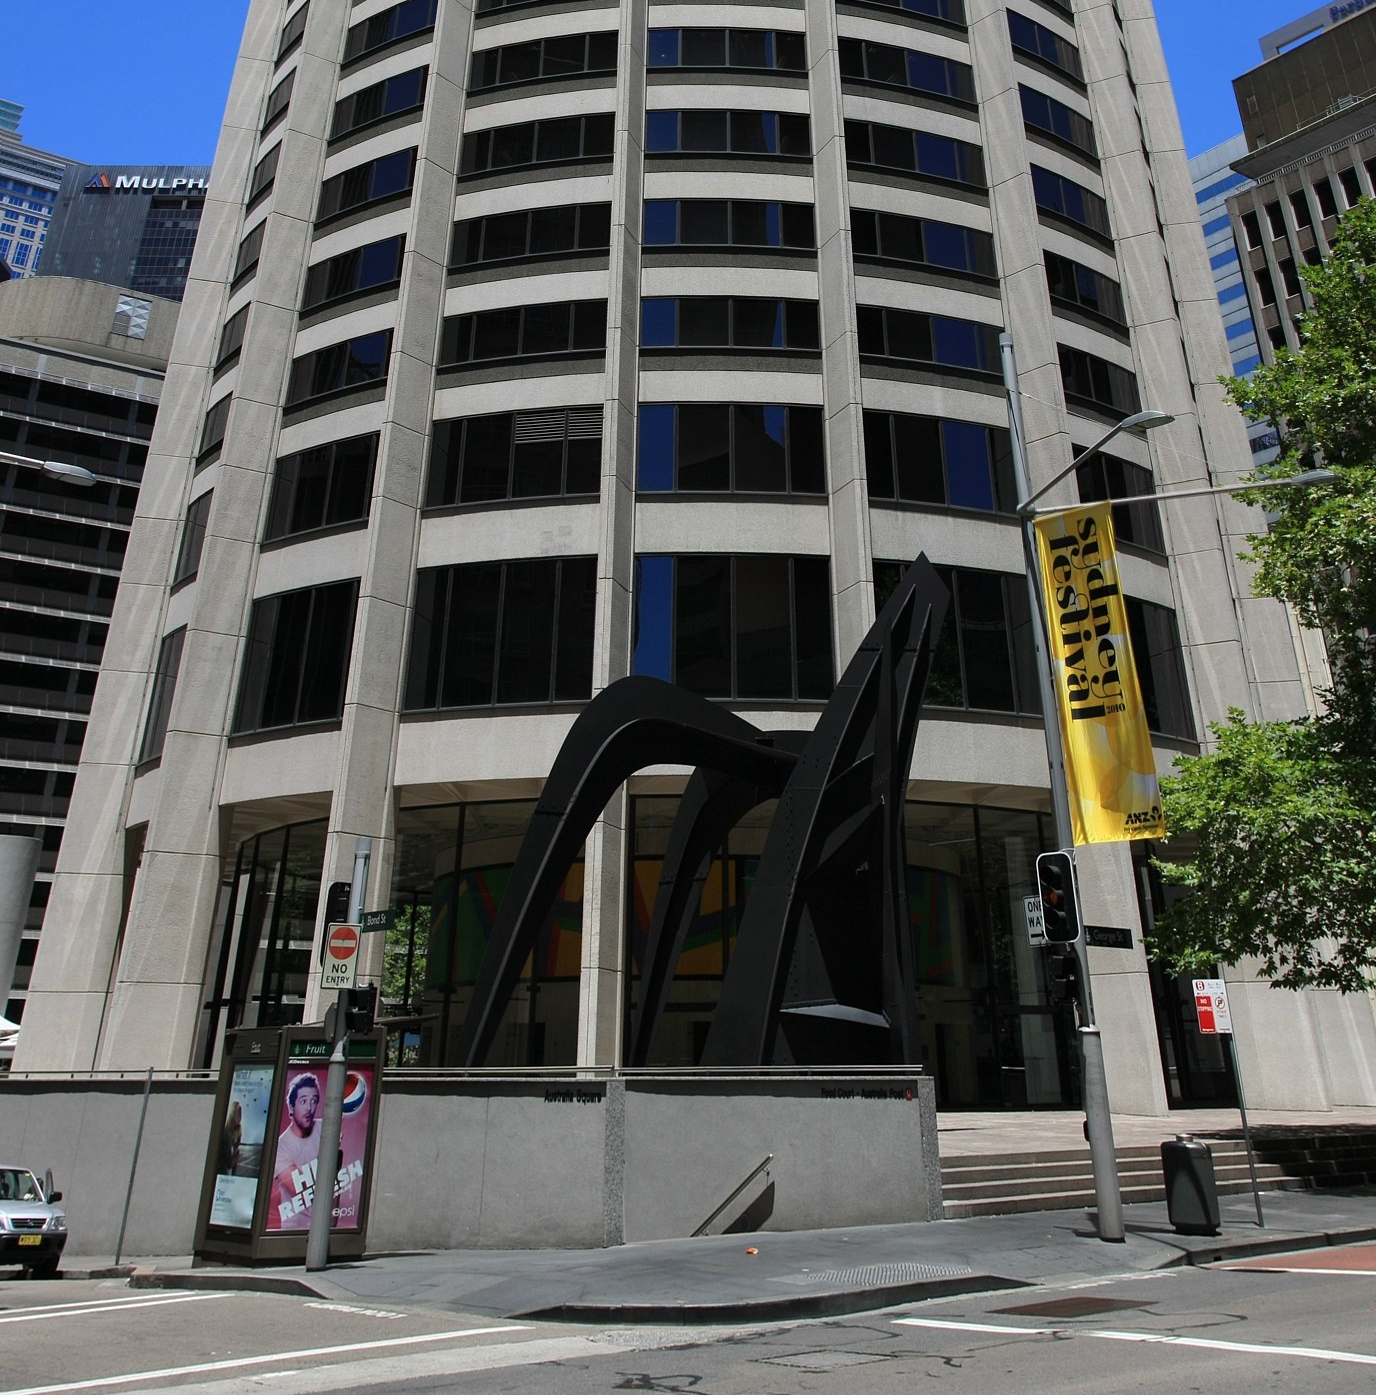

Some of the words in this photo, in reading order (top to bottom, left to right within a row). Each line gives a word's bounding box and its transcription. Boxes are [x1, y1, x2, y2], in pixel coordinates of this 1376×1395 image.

[1070, 516, 1124, 700] sydney
[1048, 533, 1106, 722] festival
[1106, 703, 1126, 715] 2010
[1125, 811, 1150, 825] ANZ
[367, 914, 381, 925] Bond
[380, 913, 386, 924] St
[331, 964, 347, 973] NO
[305, 1045, 326, 1054] Fruit
[544, 1088, 573, 1103] Australia
[577, 1088, 602, 1105] Square
[821, 1087, 836, 1099] Food
[837, 1087, 854, 1100] Court
[861, 1088, 887, 1100] Australia
[889, 1088, 904, 1100] Post
[332, 1205, 355, 1218] epsi
